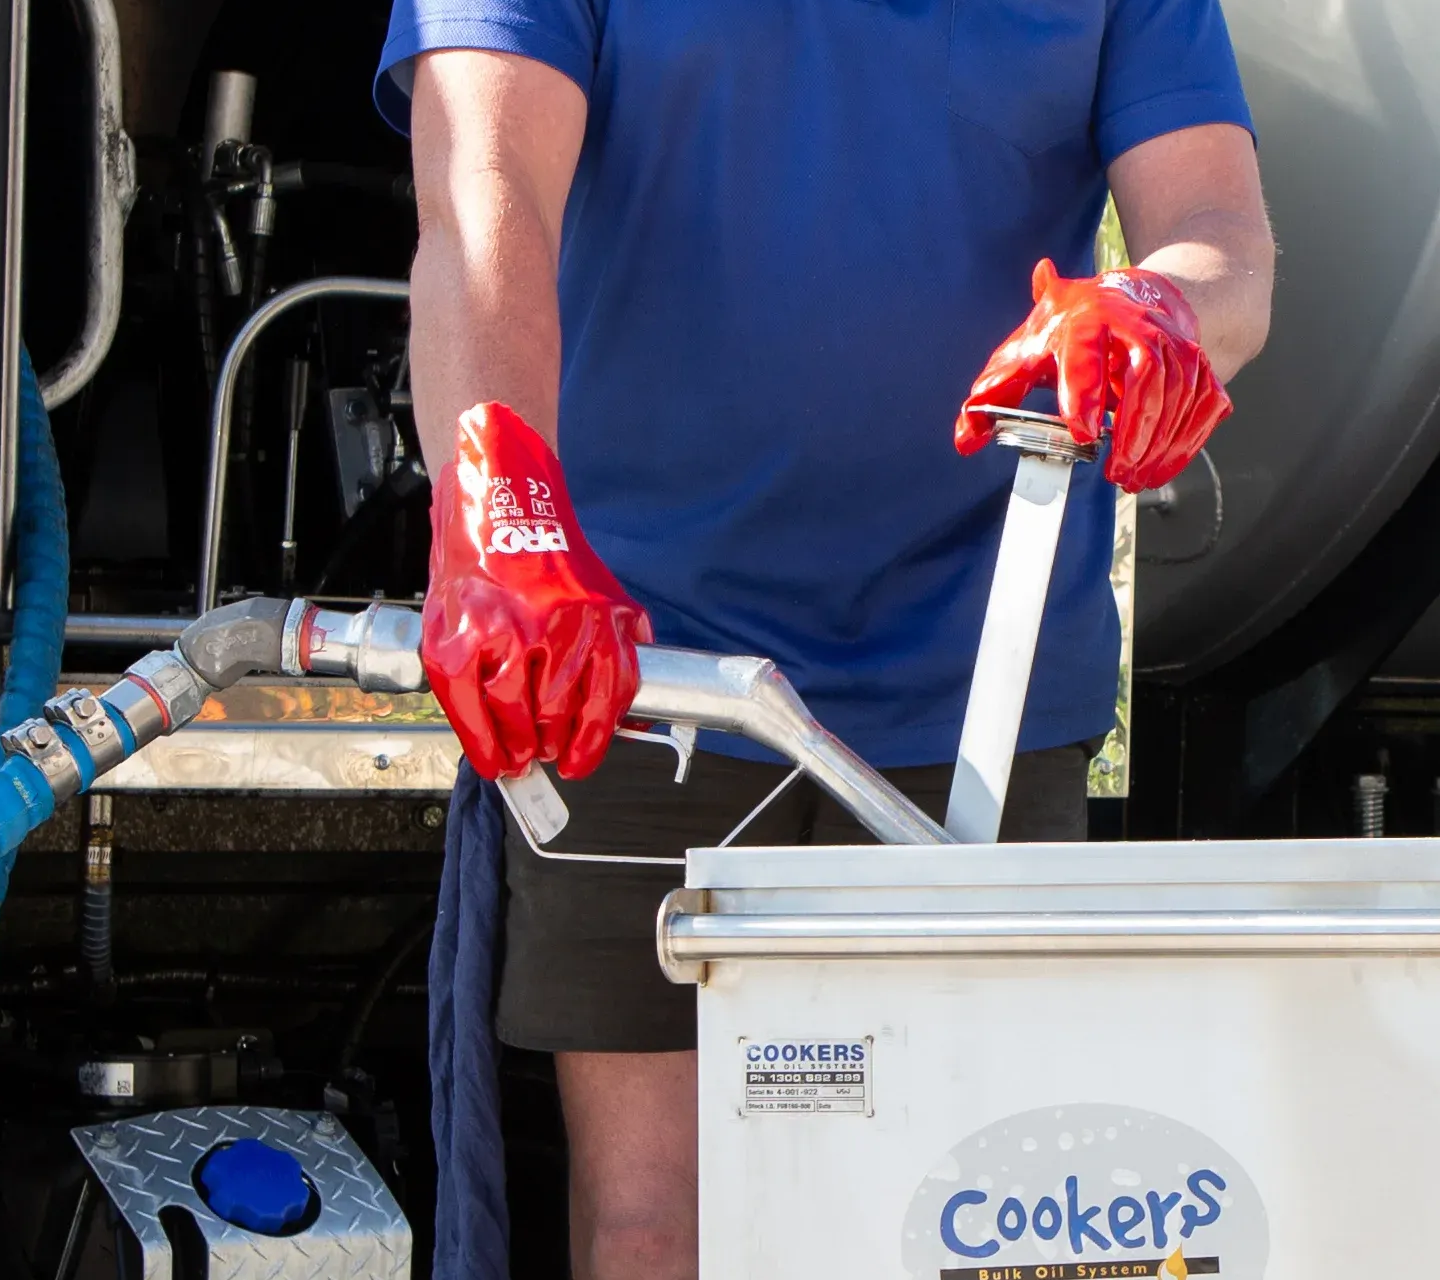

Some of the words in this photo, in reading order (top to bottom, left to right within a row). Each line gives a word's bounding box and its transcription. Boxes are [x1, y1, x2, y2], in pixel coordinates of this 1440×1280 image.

[746, 1044, 865, 1062] COOKERS
[749, 1073, 765, 1082] Ph
[769, 1073, 801, 1082] 1300
[940, 1169, 1226, 1258] Cookers
[1035, 1265, 1064, 1279] Oil
[1076, 1263, 1148, 1280] System
